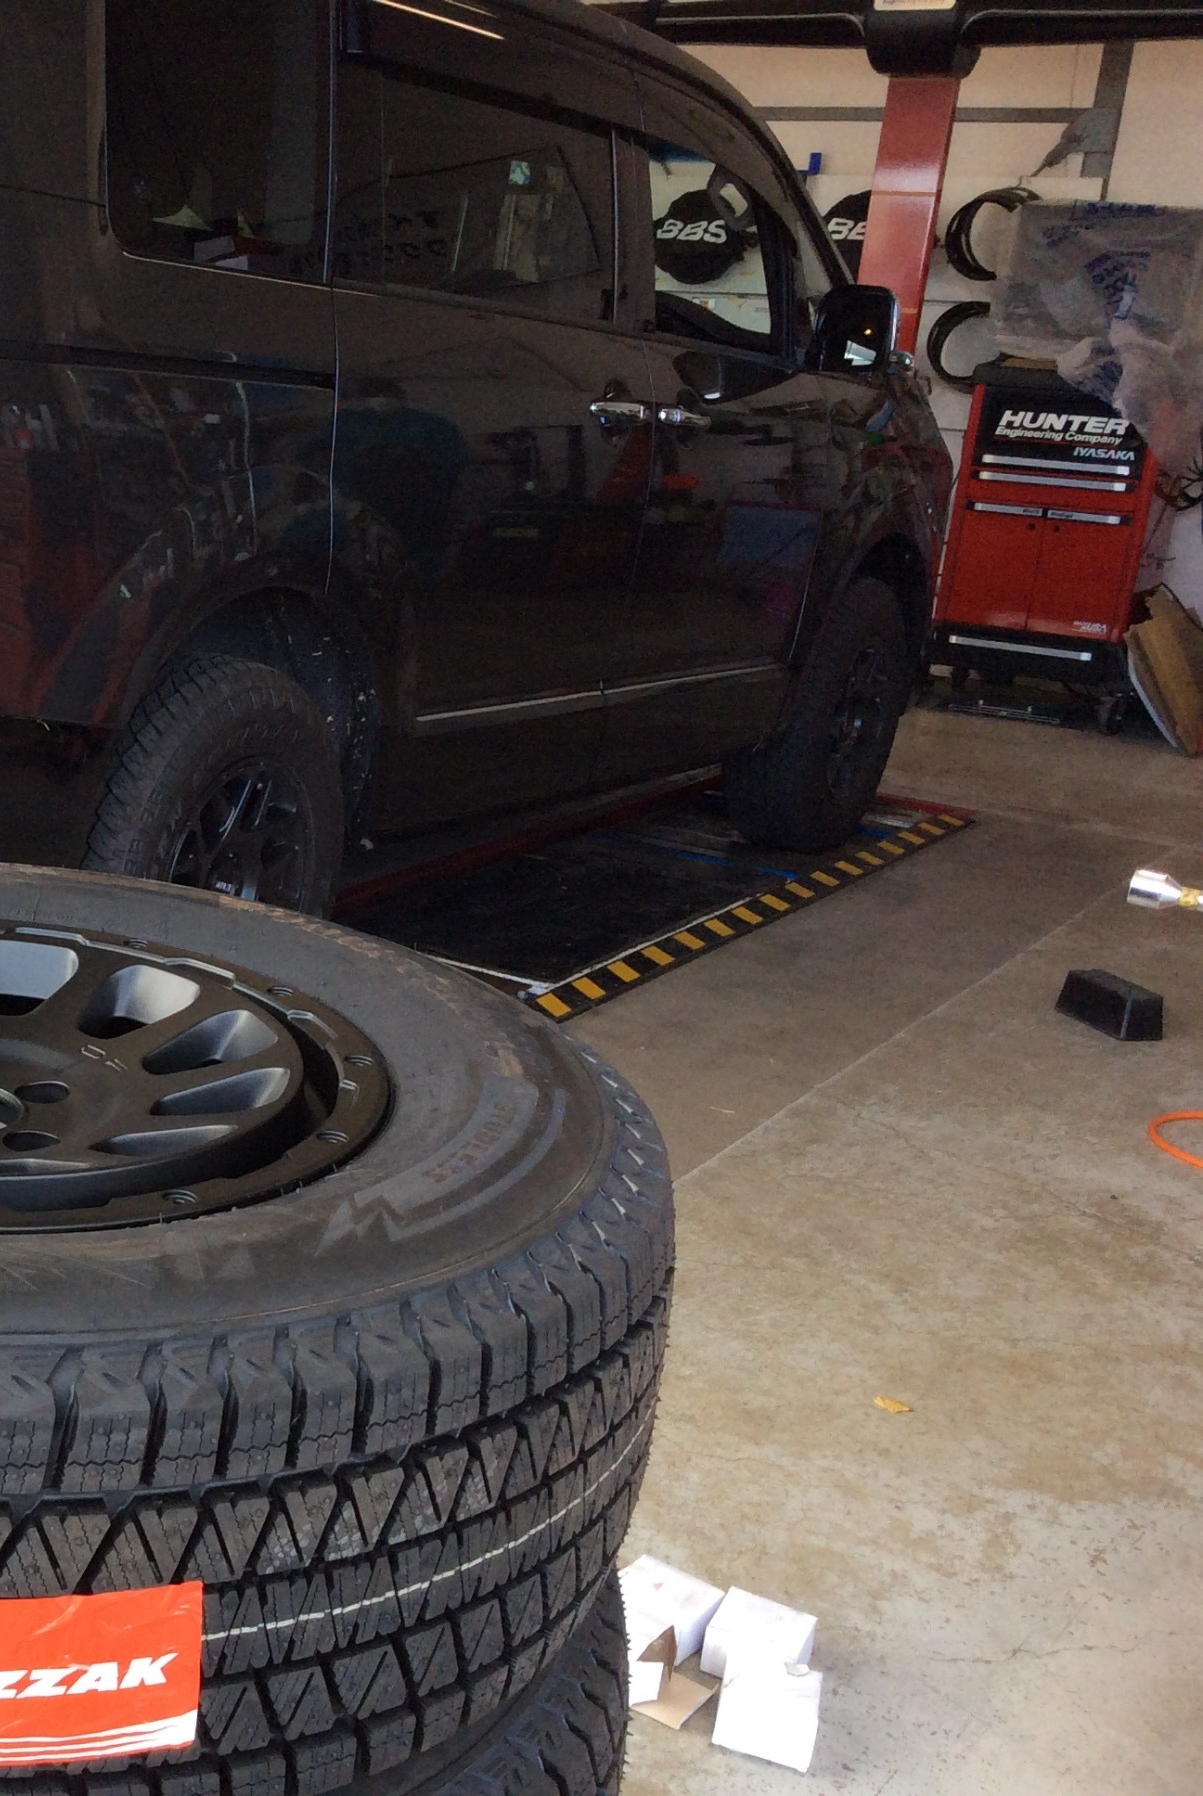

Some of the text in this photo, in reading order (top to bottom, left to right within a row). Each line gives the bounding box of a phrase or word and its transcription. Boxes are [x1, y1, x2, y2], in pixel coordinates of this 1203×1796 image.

[656, 218, 728, 244] BBS
[998, 410, 1130, 436] HUNTER
[995, 425, 1123, 446] Engineering Company
[1073, 446, 1135, 461] IYASAKA
